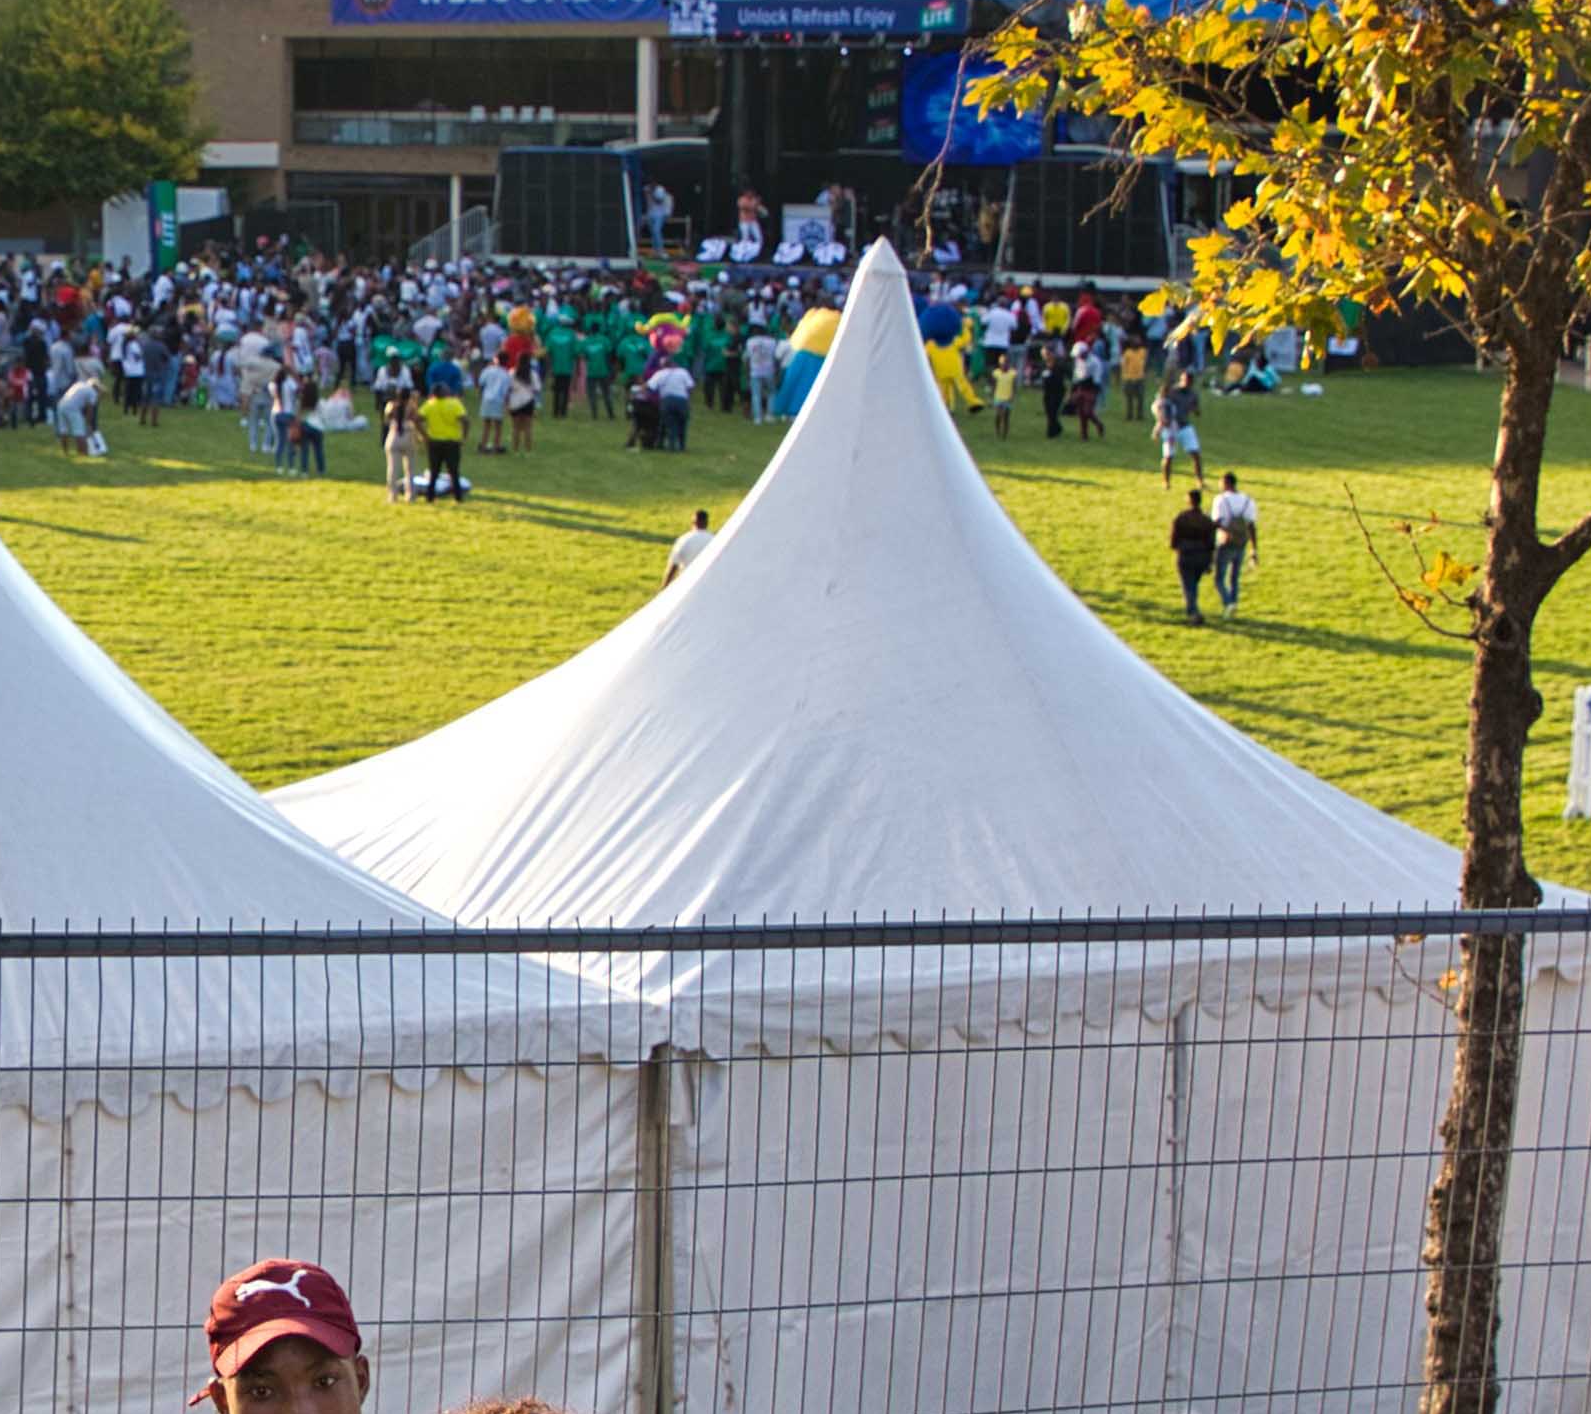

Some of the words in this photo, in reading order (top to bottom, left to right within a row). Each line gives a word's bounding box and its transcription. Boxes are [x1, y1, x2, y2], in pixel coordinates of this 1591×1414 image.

[737, 7, 788, 27] Unlock
[792, 6, 850, 27] Refresh
[854, 5, 896, 30] Enjoy
[921, 6, 953, 28] LITE
